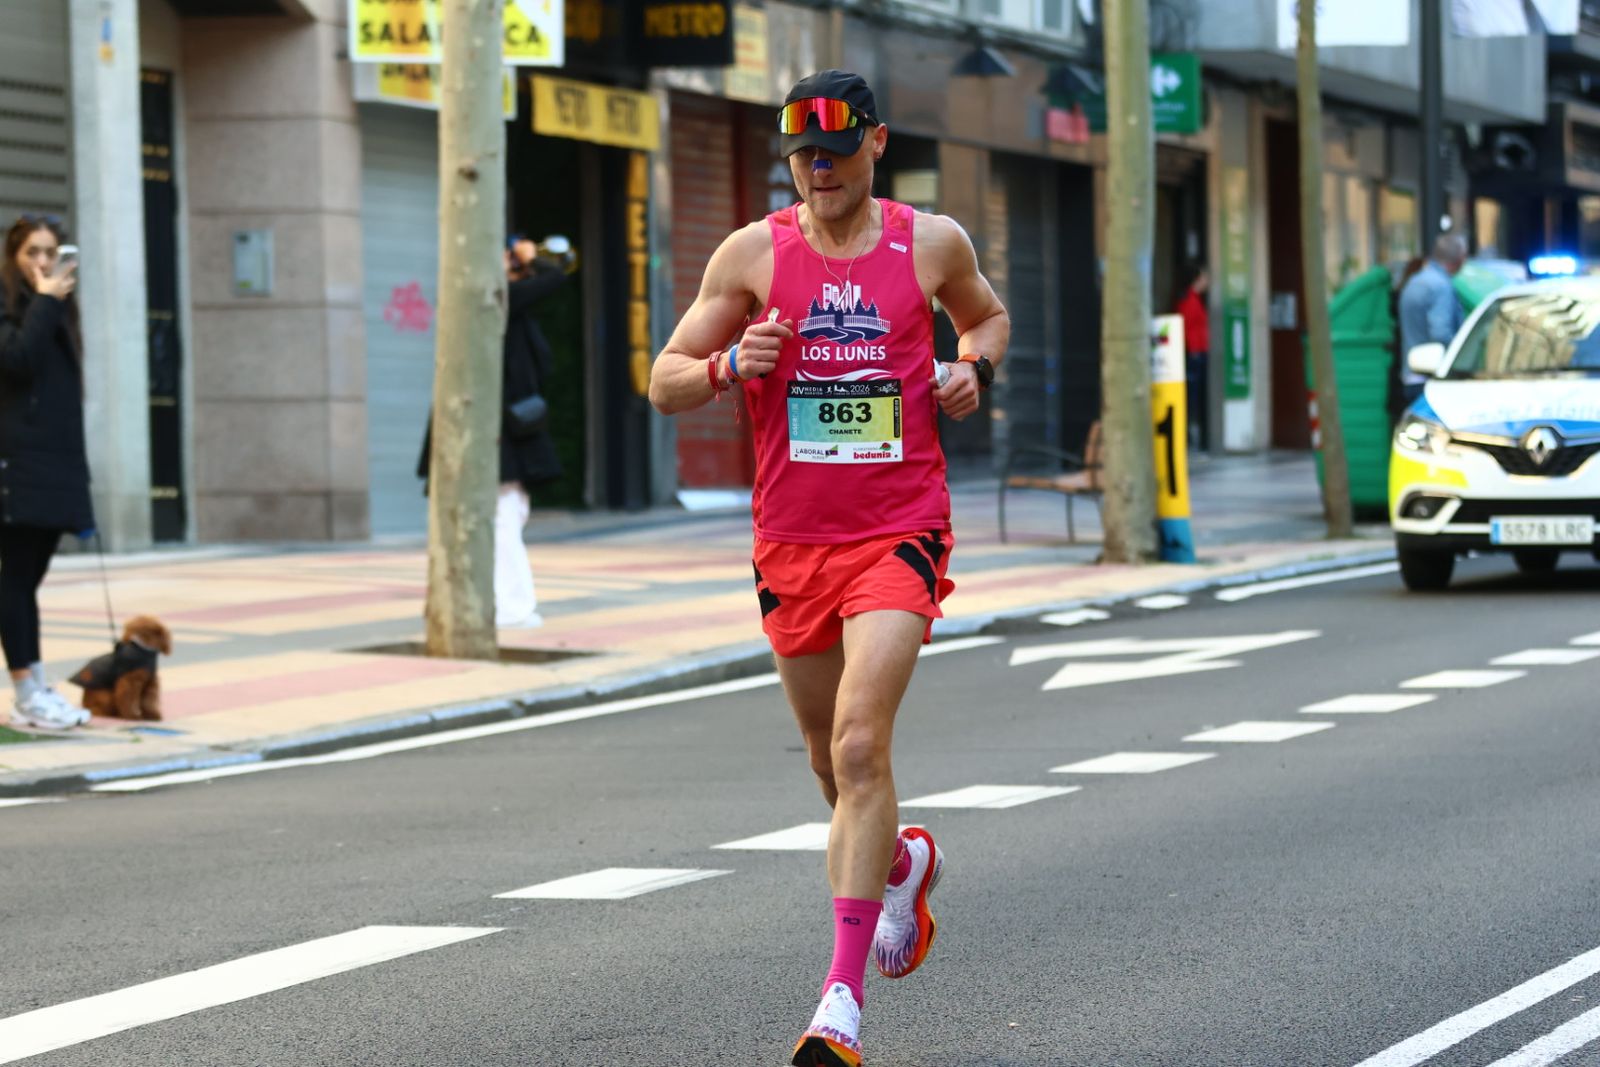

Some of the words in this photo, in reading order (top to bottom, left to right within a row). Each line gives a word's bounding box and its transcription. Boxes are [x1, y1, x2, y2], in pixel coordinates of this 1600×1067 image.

[802, 345, 831, 361] LOS
[835, 345, 886, 361] LUNES
[791, 386, 805, 395] XIV
[850, 385, 870, 393] 2026
[819, 402, 872, 424] 863
[795, 448, 824, 456] LABORAL
[853, 451, 891, 459] bedunia
[1156, 405, 1178, 496] 1
